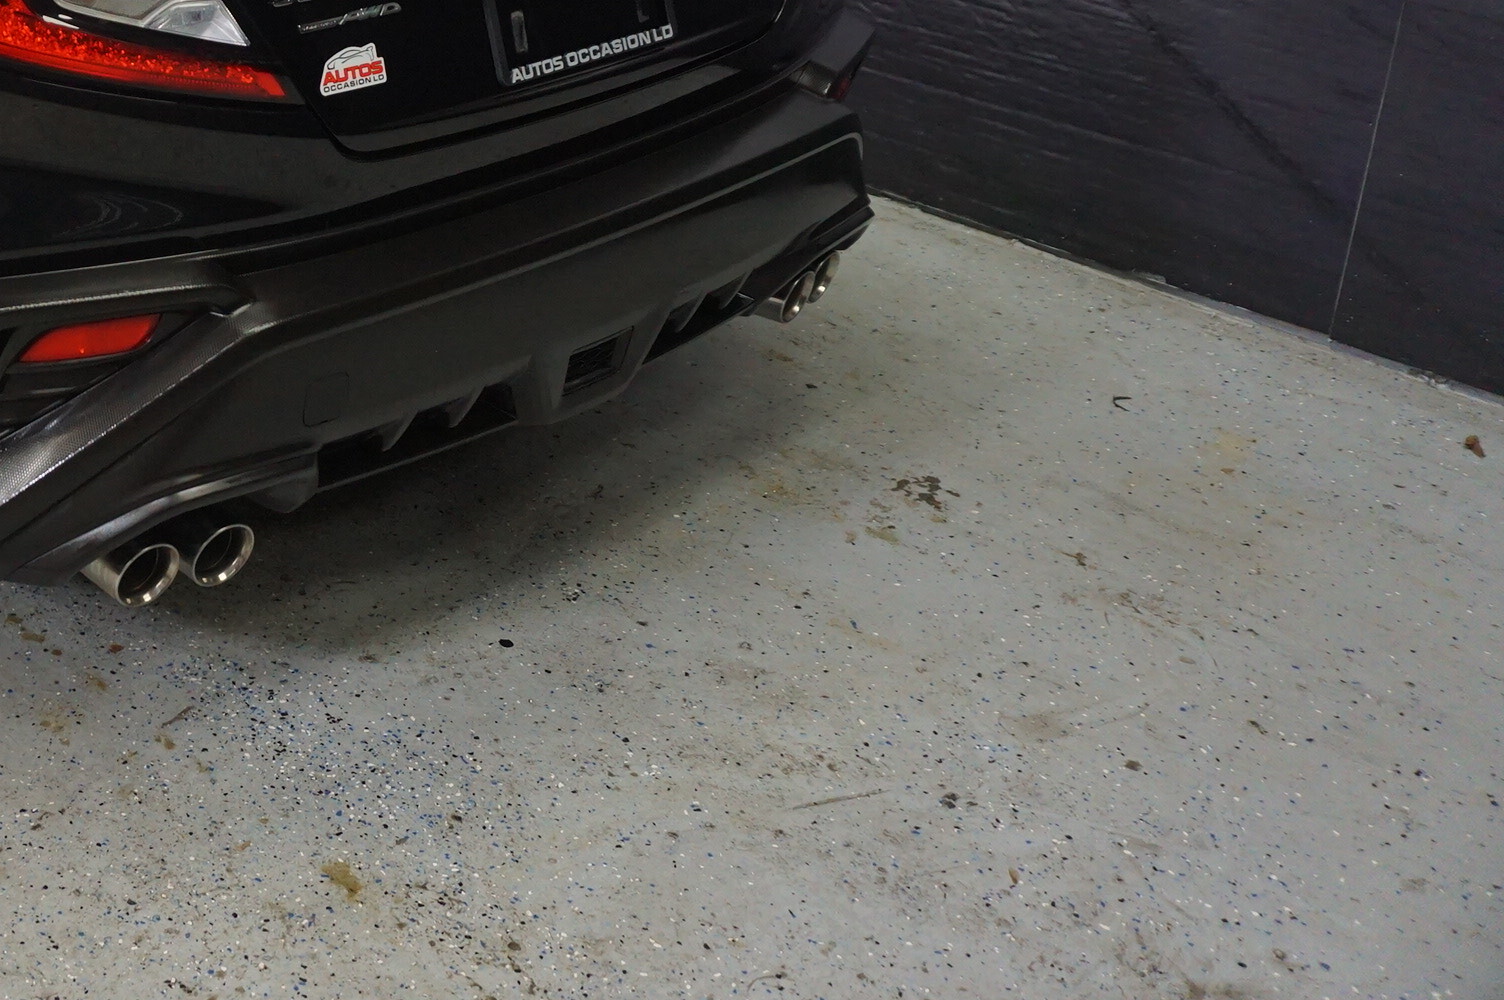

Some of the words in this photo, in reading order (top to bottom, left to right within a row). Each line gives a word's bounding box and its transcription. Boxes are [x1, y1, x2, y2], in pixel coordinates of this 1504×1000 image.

[511, 54, 565, 84] AUTOS
[565, 31, 652, 67] OCCASION
[652, 24, 674, 42] LD
[323, 61, 383, 86] AUTOS
[323, 77, 372, 94] OCCASION
[372, 73, 385, 83] LD
